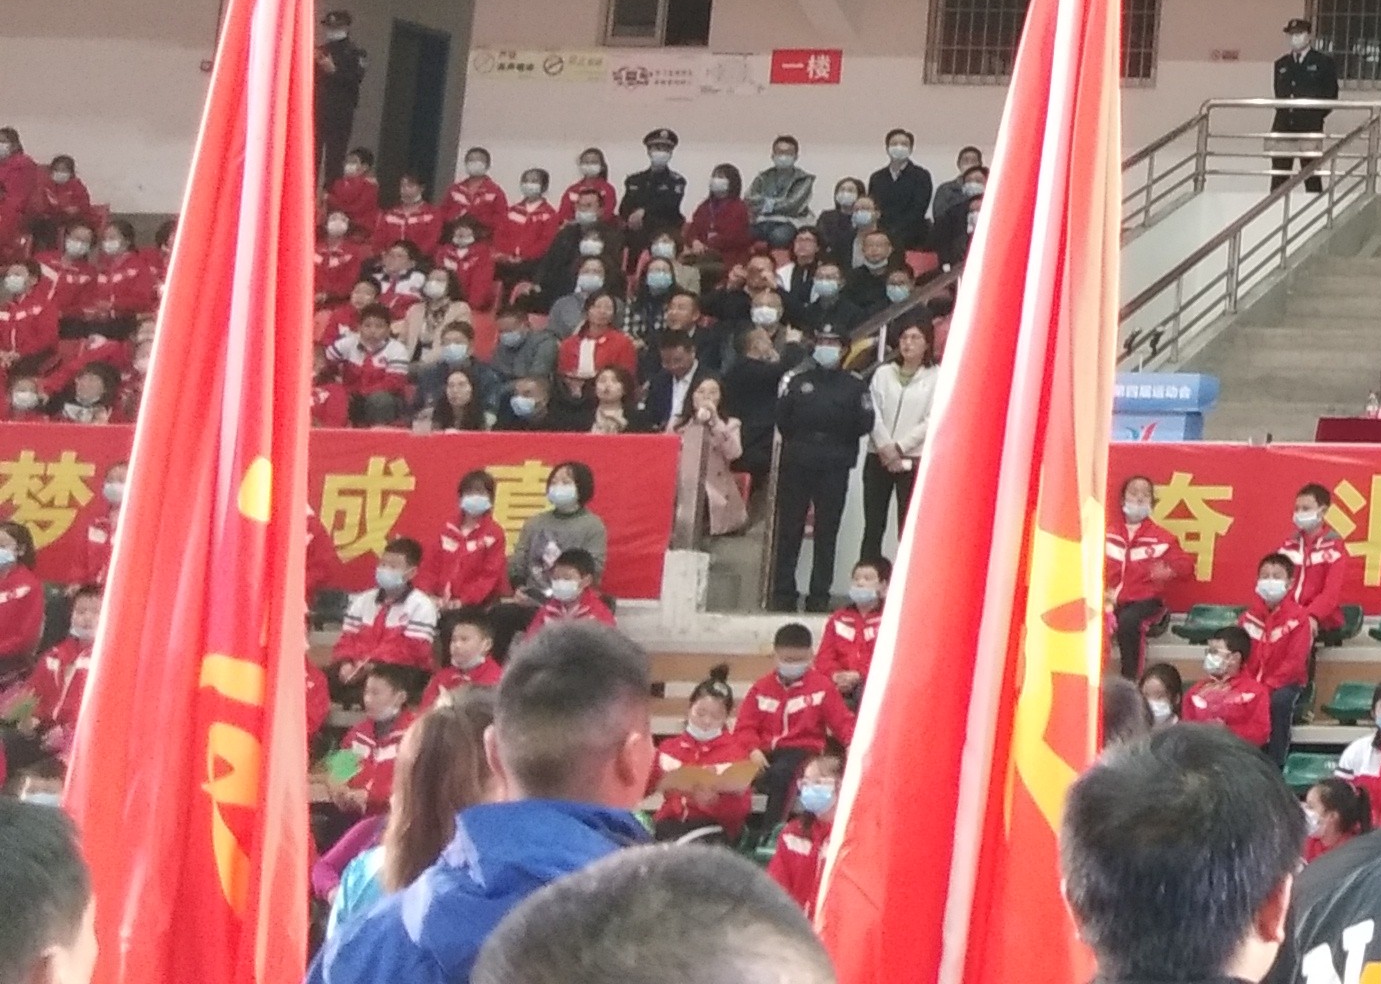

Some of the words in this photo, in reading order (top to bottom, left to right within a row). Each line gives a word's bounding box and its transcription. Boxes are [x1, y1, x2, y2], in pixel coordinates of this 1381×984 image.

[781, 53, 832, 79] 一楼
[0, 449, 555, 564] 梦成真
